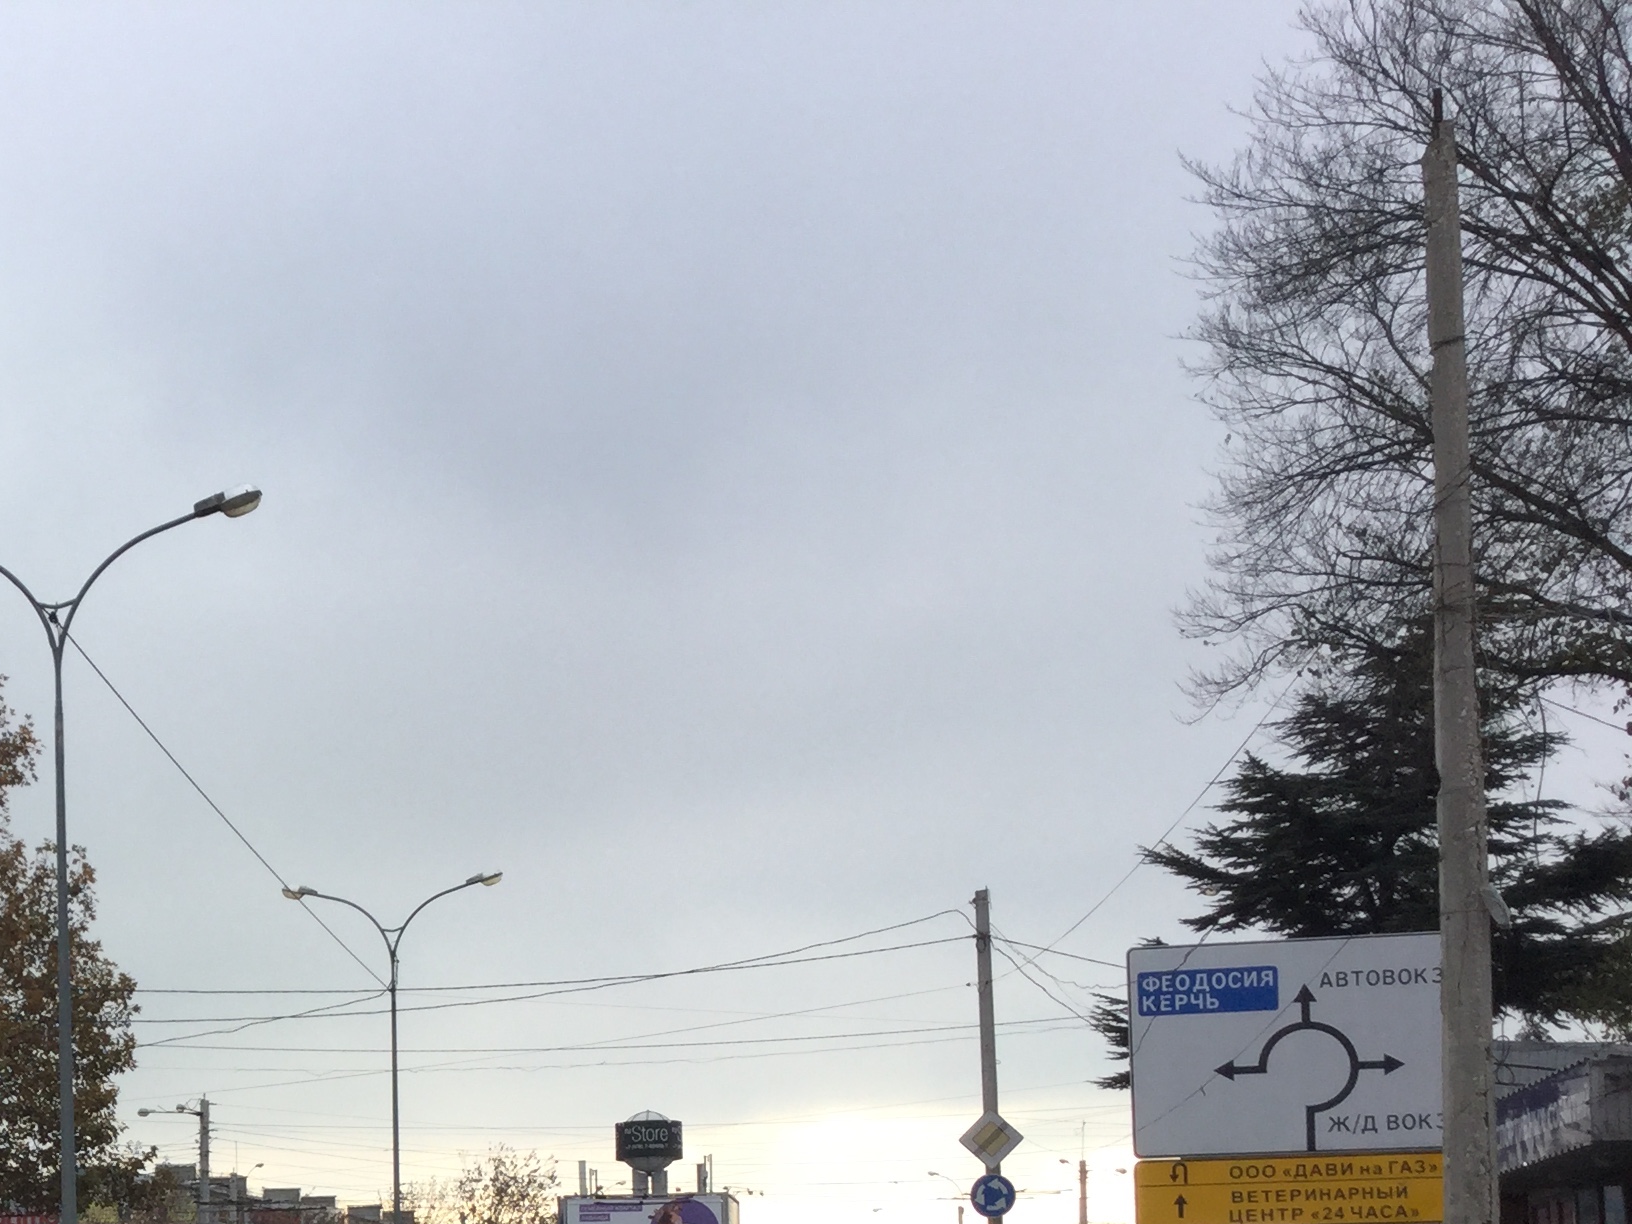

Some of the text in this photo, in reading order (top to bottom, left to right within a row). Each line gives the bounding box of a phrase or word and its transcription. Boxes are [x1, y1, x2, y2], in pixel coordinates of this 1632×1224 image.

[1142, 970, 1274, 992] ФЕОДОСИЯ
[1319, 967, 1443, 988] АВТОВОКЗ
[1142, 993, 1220, 1012] КЕРЧЬ
[1327, 1113, 1443, 1134] Ж/Д ВОК
[1229, 1160, 1437, 1179] ООО «ДАВИ на ГАЗ»
[1231, 1184, 1409, 1203] ВЕТЕРИНАРНЫЙ
[1229, 1204, 1420, 1224] ЦЕНТР «24 ЧАСА»
